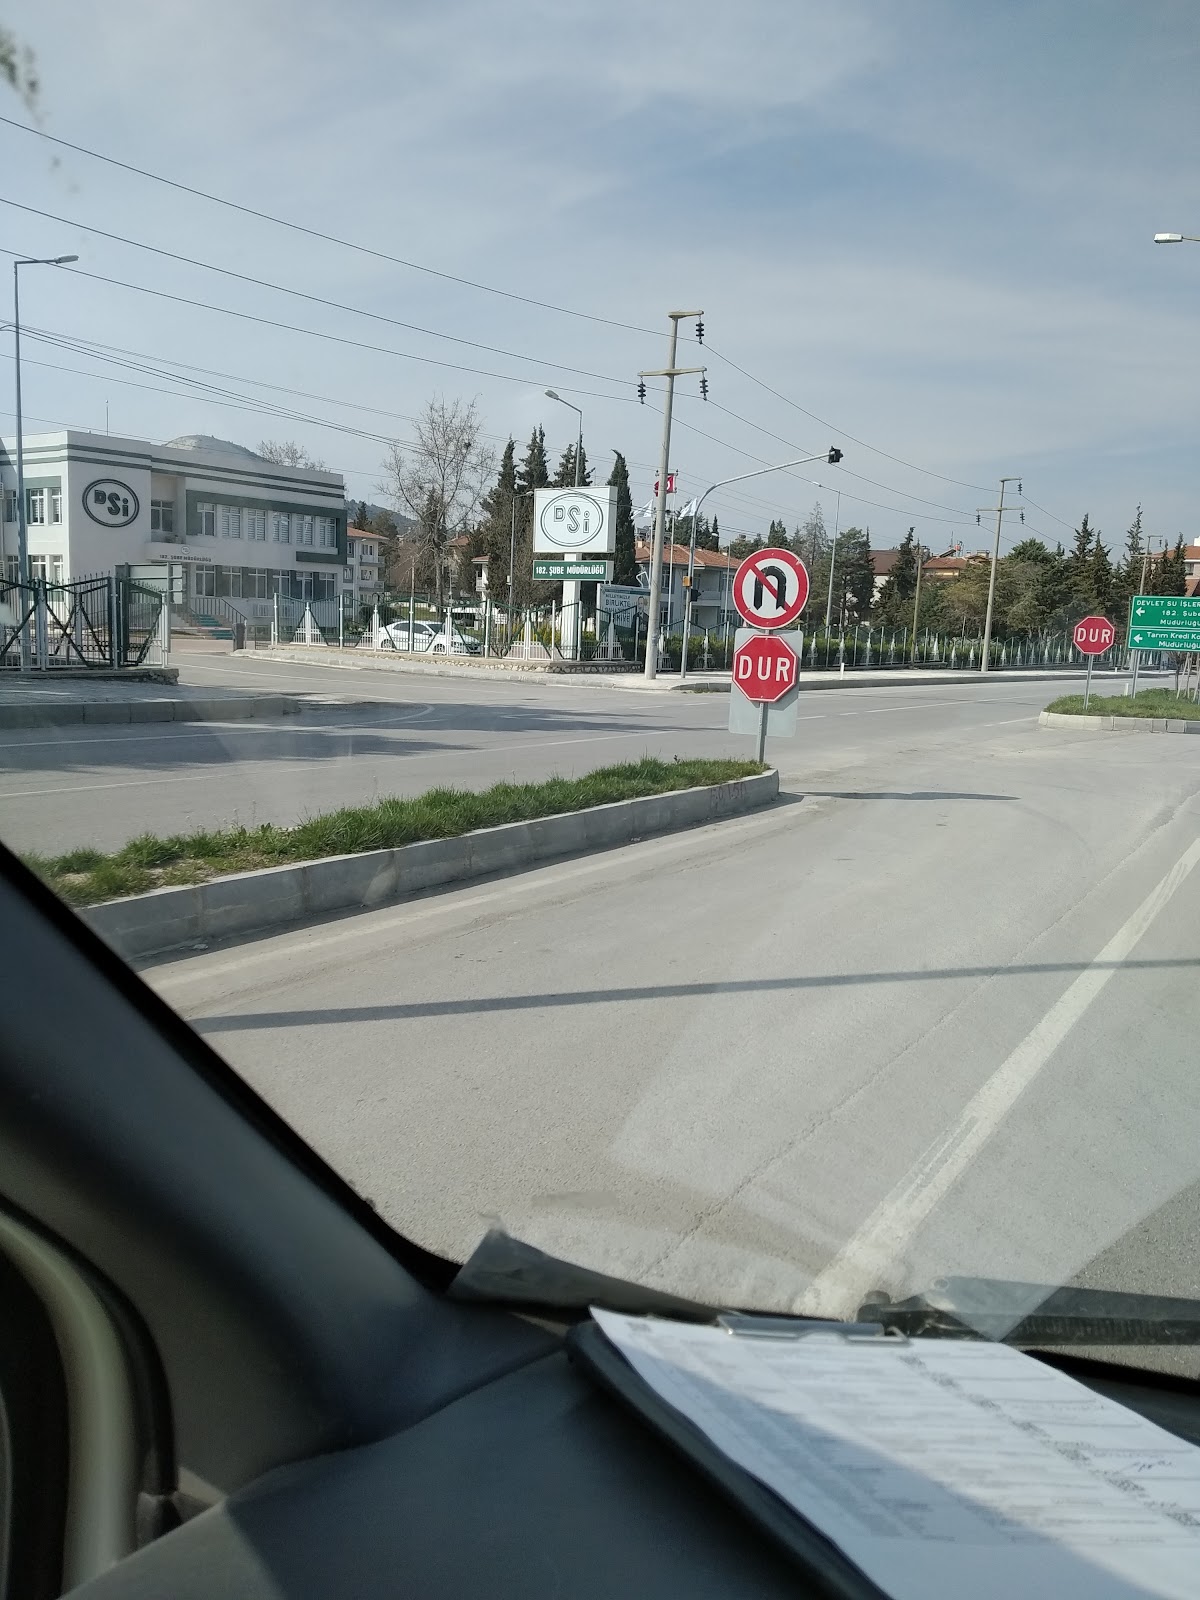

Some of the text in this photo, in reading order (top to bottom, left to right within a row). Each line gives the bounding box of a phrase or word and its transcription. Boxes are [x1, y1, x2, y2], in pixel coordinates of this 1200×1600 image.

[535, 564, 605, 577] 182. ŞUBE MÜDÜRLÜĞÜ
[1136, 599, 1165, 607] DEVLET
[1076, 627, 1111, 644] DUR
[1147, 631, 1169, 639] Tarım
[1170, 632, 1190, 640] Kredi
[738, 655, 791, 682] DUR
